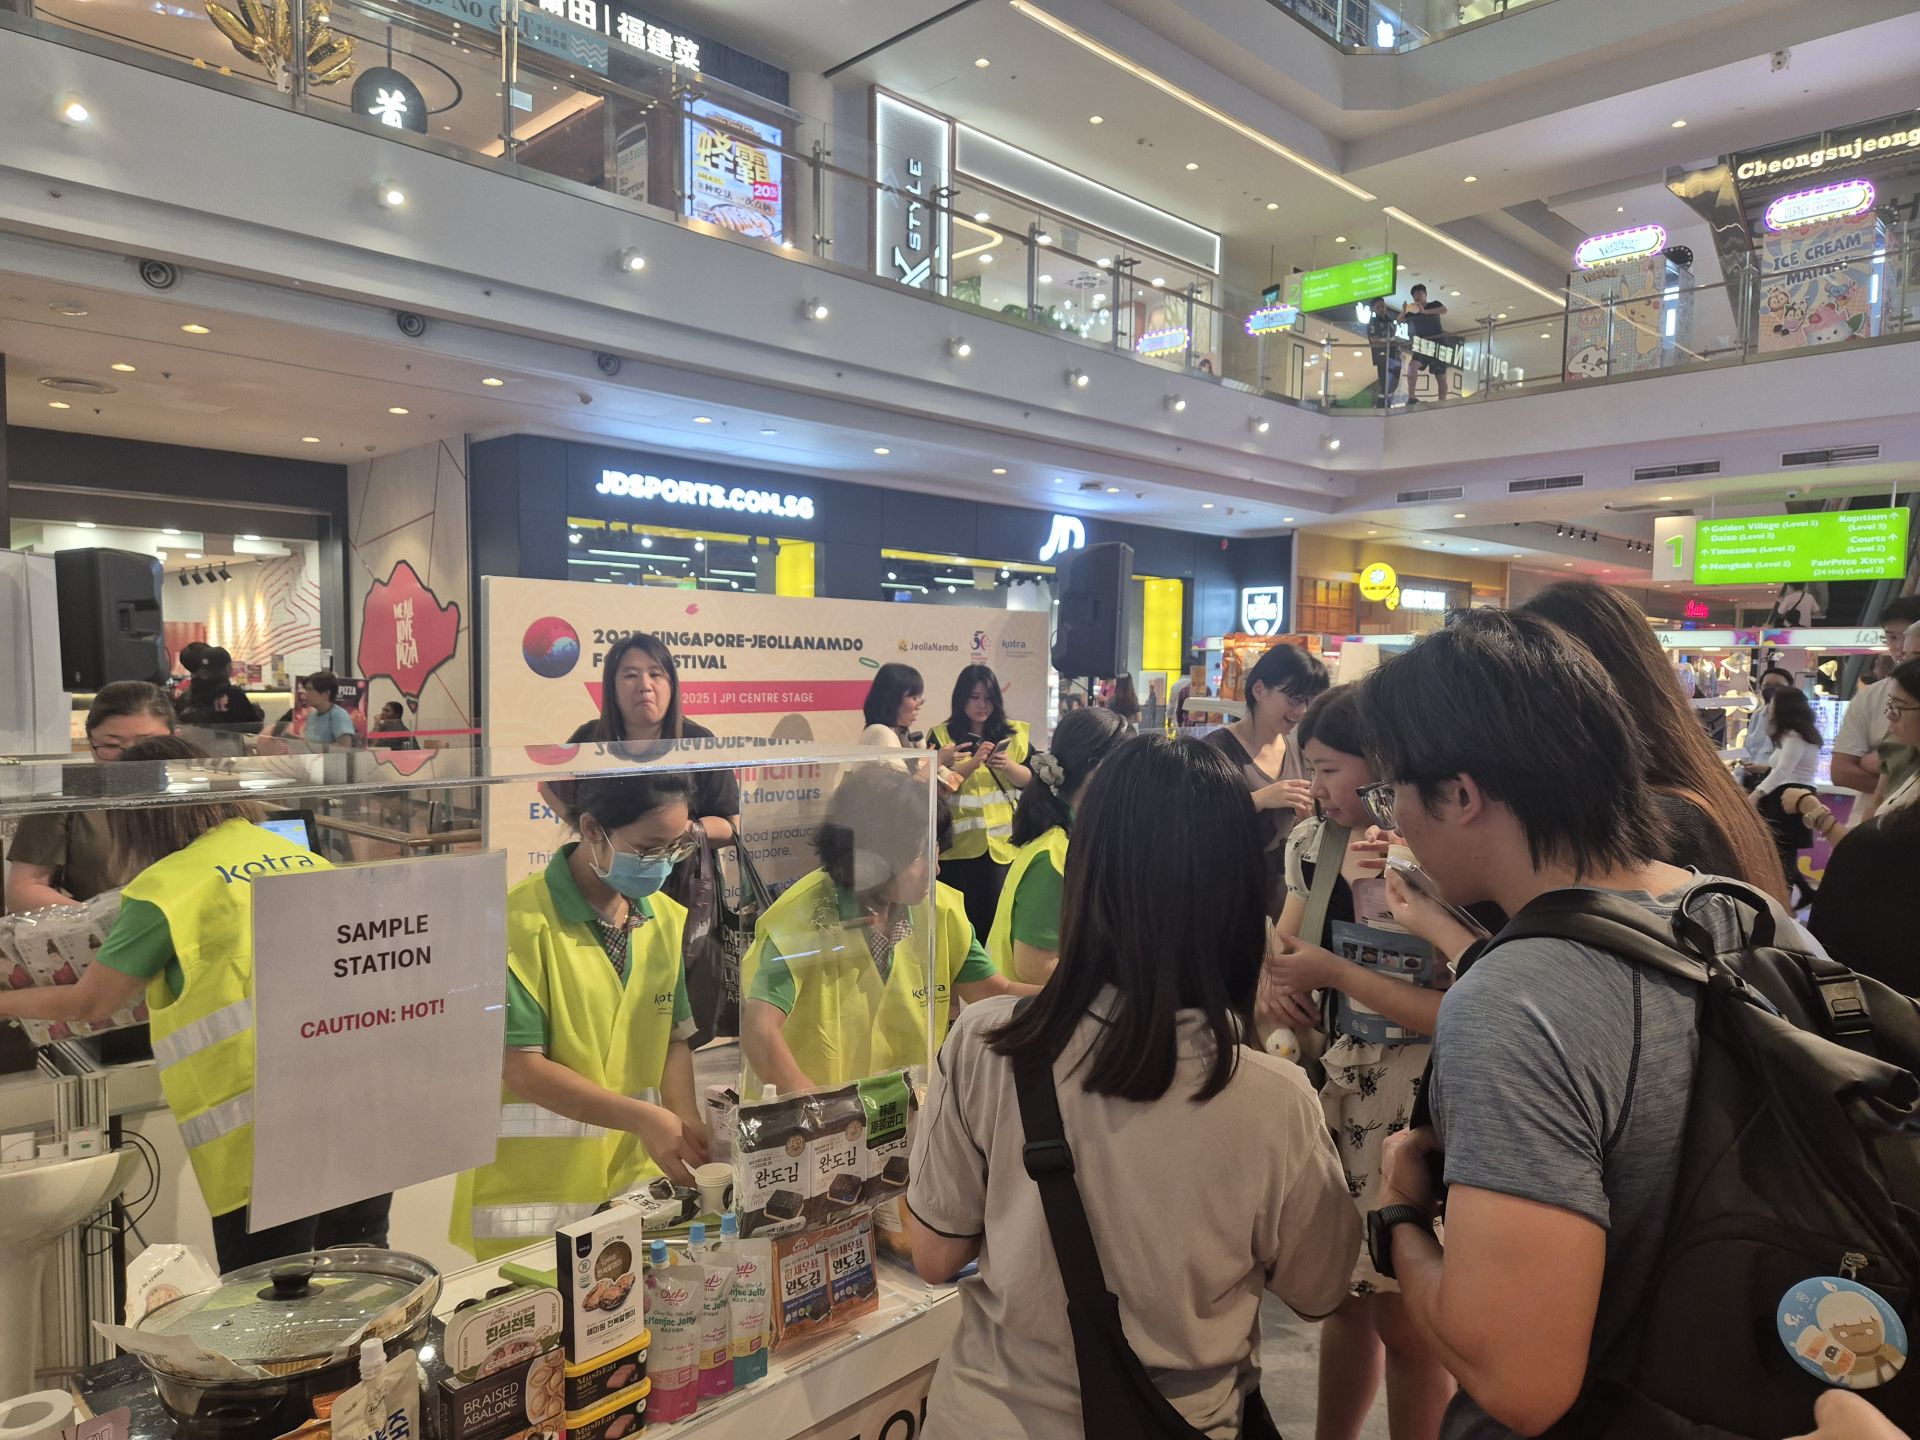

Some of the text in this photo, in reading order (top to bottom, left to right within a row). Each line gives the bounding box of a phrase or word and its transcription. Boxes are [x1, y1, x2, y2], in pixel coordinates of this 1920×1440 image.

[617, 12, 701, 72] 福建菜
[1737, 128, 1920, 180] Cheongsujeong
[908, 157, 922, 250] STYLE
[1774, 232, 1862, 271] ICE CREAM
[595, 469, 815, 520] JDSPORTS.COM.SG
[1711, 523, 1745, 533] Golden
[1748, 521, 1780, 531] Village
[1782, 520, 1808, 529] (Level
[1839, 513, 1888, 523] Kopitiam
[1711, 534, 1737, 543] Daiso
[1739, 533, 1765, 542] (Level
[1850, 534, 1886, 544] Courts
[1664, 534, 1685, 568] 1
[1709, 546, 1757, 555] Timezone
[1759, 545, 1784, 554] (Level
[1709, 561, 1753, 571] Mongkok
[1755, 560, 1780, 570] (Level
[1811, 556, 1885, 567] FairPrice Xtra
[393, 598, 414, 619] WE ALL
[651, 630, 864, 651] SINGAPORE-JEOLLANAMDO
[910, 641, 959, 652] JeollaNamdo
[1002, 639, 1026, 649] kotra
[674, 654, 727, 669] STIVAL
[338, 685, 357, 697] PIZZA
[682, 692, 710, 704] 2025
[739, 692, 779, 704] CENTRE
[782, 692, 814, 703] STAGE
[754, 786, 821, 805] flavours
[215, 854, 315, 884] kotra
[336, 914, 429, 945] SAMPLE
[333, 946, 432, 979] STATION
[300, 998, 445, 1039] CAUTION: HOT!
[818, 1146, 857, 1174] 완도김
[754, 1161, 800, 1189] 완도김
[486, 1311, 536, 1346] 진심전복
[678, 1312, 697, 1325] Jelly
[463, 1382, 520, 1416] BRAISED
[463, 1396, 519, 1428] ABALONE
